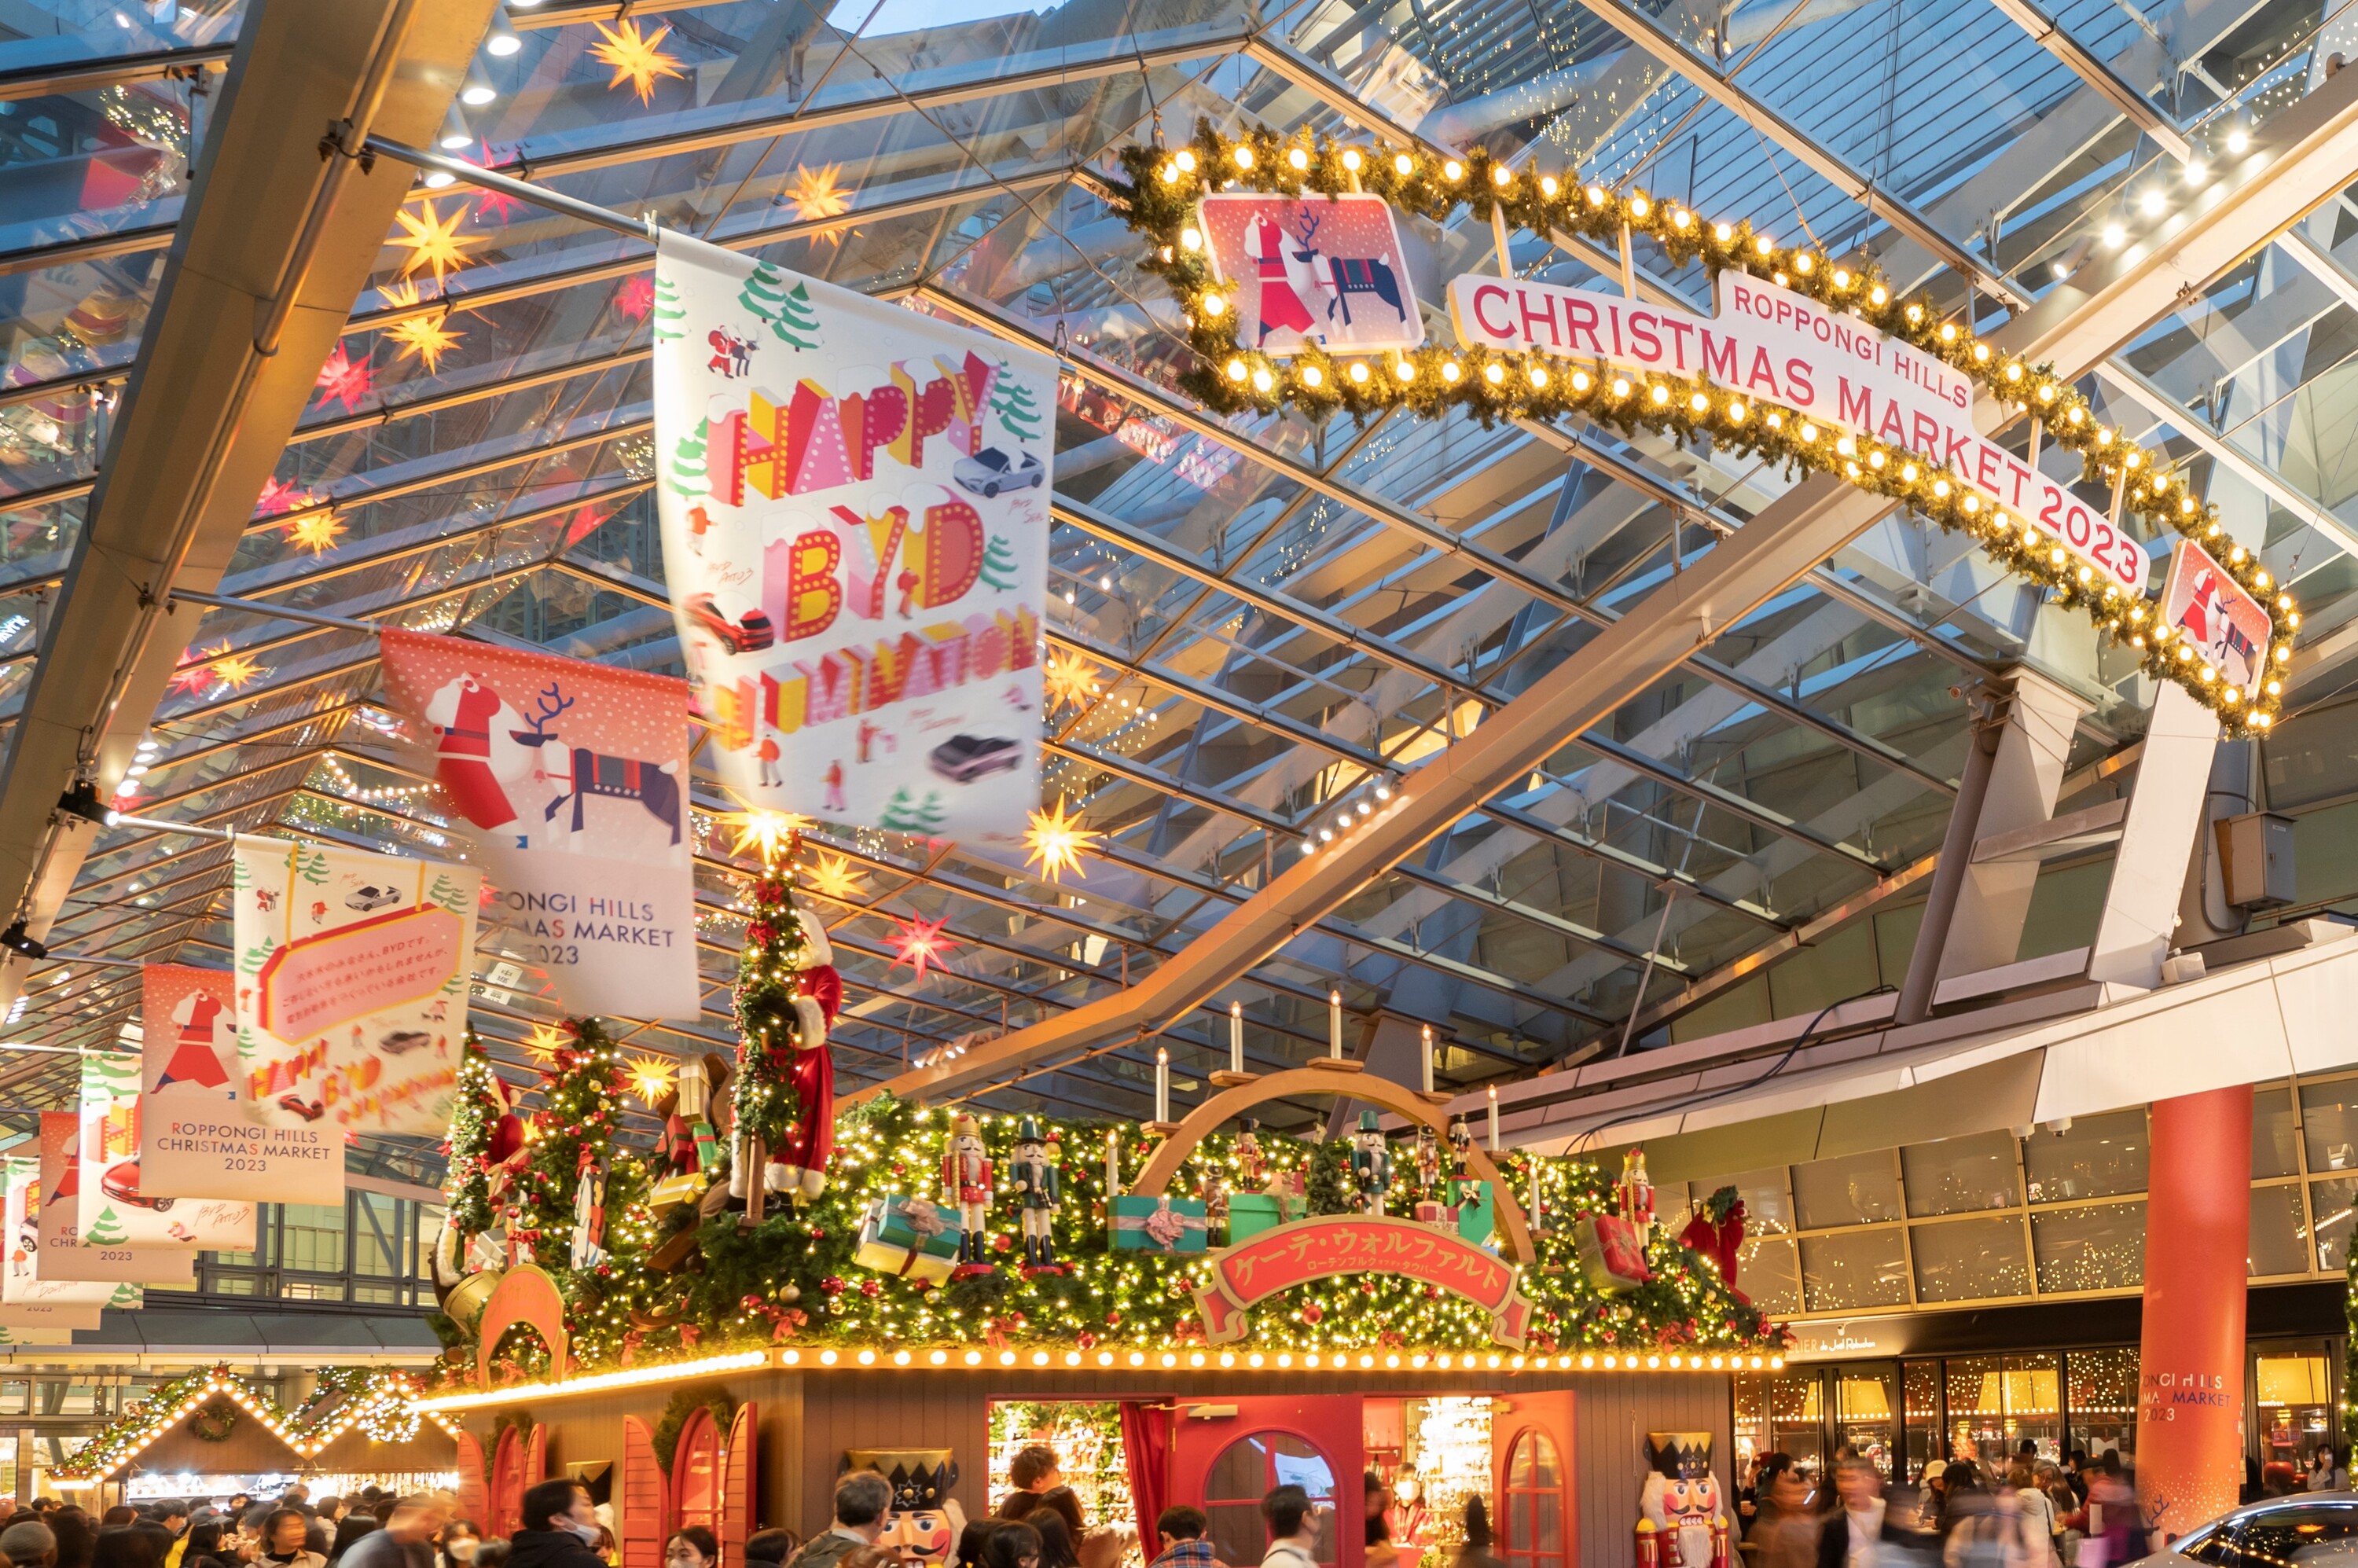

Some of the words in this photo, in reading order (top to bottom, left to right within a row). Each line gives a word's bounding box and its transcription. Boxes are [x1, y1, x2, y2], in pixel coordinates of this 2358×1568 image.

[1733, 284, 1882, 366] ROPPONGI
[1893, 351, 1967, 409] HILLS
[707, 347, 1001, 508] HAPPY
[1473, 284, 1816, 406] CHRISTMAS
[1838, 375, 2032, 509] MARKET
[2038, 485, 2139, 585] 2023
[761, 481, 984, 644] BYD
[590, 897, 655, 922] HILLS
[573, 920, 674, 948] MARKET
[171, 1122, 266, 1140] ROPPONGI
[274, 1129, 318, 1144] HILLS
[157, 1137, 259, 1156] CHRISTMAS
[263, 1144, 331, 1160] MARKET
[224, 1157, 266, 1172] 2023
[193, 1203, 226, 1228] BYD
[100, 1250, 133, 1261] 2023
[1234, 1226, 1499, 1291] ケーテ・ウォルファルト
[2172, 1390, 2231, 1408] MARKET
[2144, 1408, 2175, 1422] 2023
